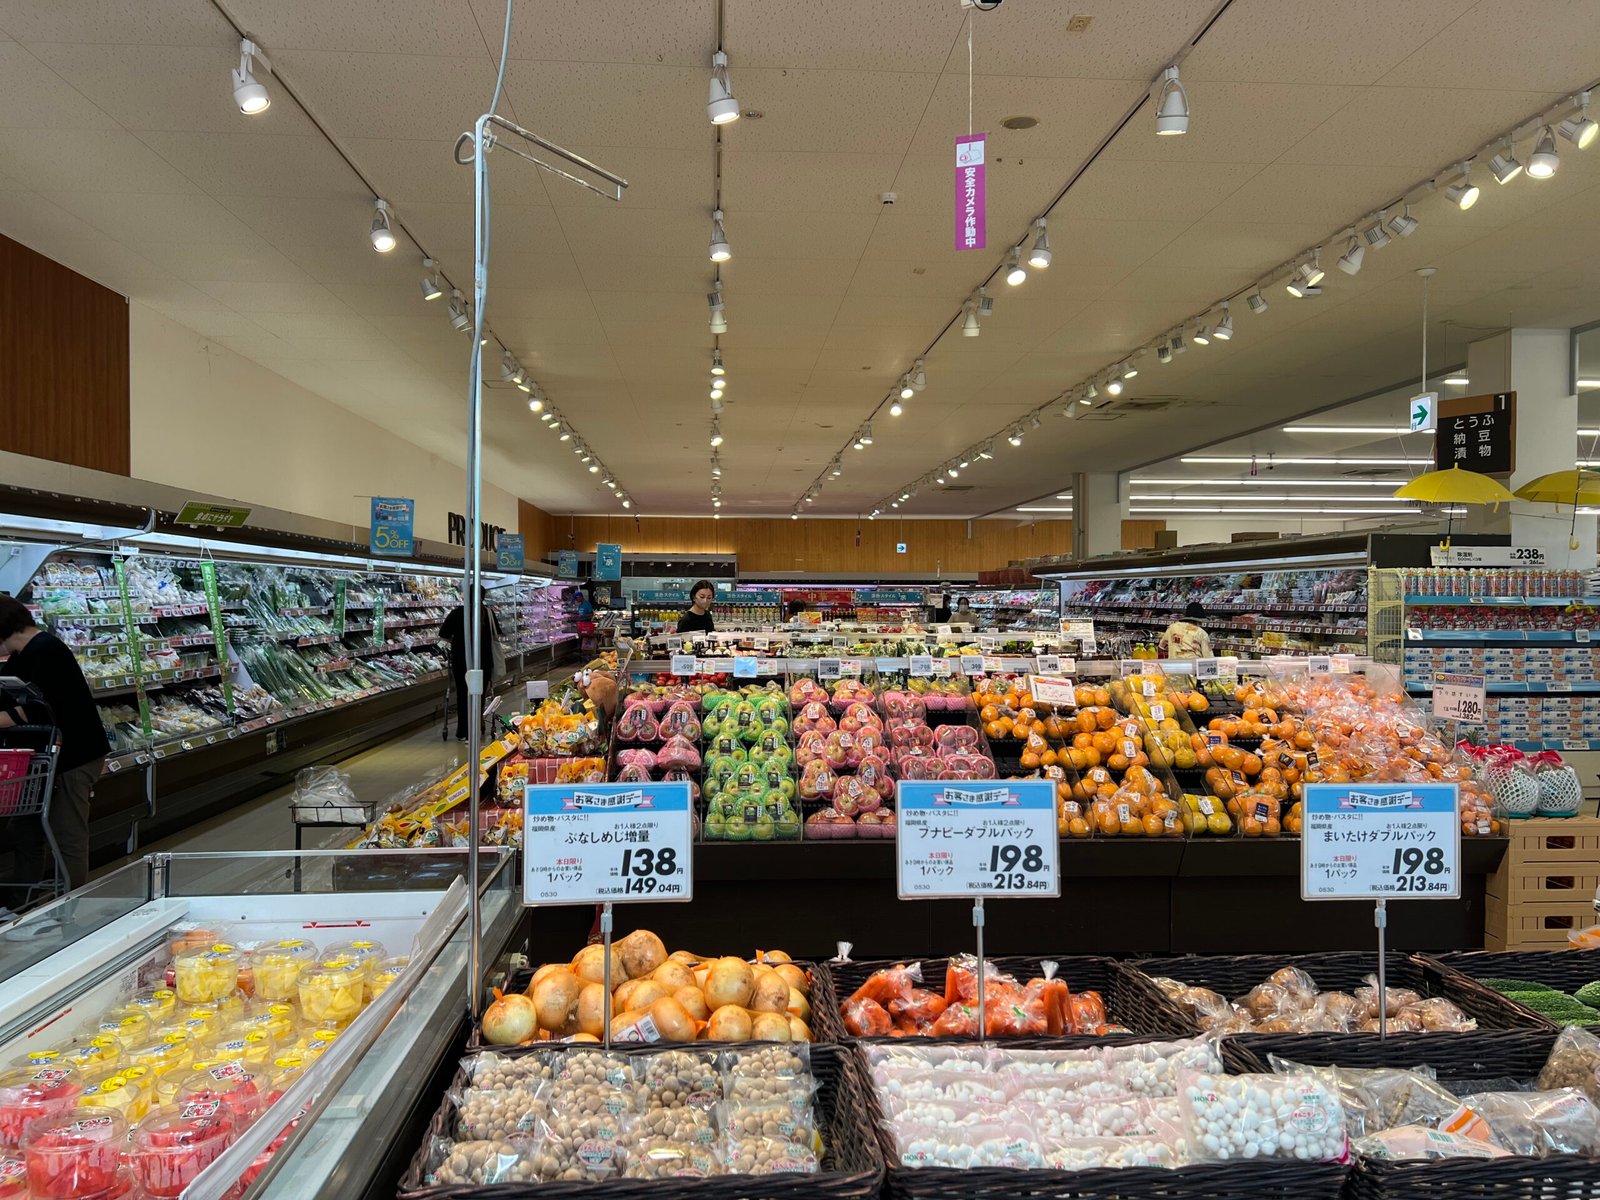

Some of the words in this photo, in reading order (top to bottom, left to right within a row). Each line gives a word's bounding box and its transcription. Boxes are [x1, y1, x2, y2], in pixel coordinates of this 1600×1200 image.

[964, 166, 976, 248] 安全カメラ作動中
[1498, 394, 1506, 411] 1
[1453, 414, 1494, 430] とうふ
[1453, 429, 1491, 445] 納豆
[1454, 445, 1493, 460] 漬物
[390, 540, 409, 549] OFF
[1516, 548, 1544, 560] 238円
[575, 792, 641, 807] お客さま感謝デー
[945, 790, 1008, 803] お客さま感謝デー
[1350, 793, 1412, 807] お客さま感謝デー
[564, 830, 650, 844] ぶなしめじ増量
[918, 826, 1034, 839] ブナピーダブルパック
[1323, 829, 1436, 843] まいたけダブルパック
[556, 857, 583, 865] 本日限り
[621, 847, 683, 877] 138円
[989, 844, 1050, 873] 198円
[1392, 847, 1451, 875] 198円
[547, 872, 583, 883] 1パック
[920, 866, 954, 876] 1パック
[1325, 868, 1358, 879] 1パック
